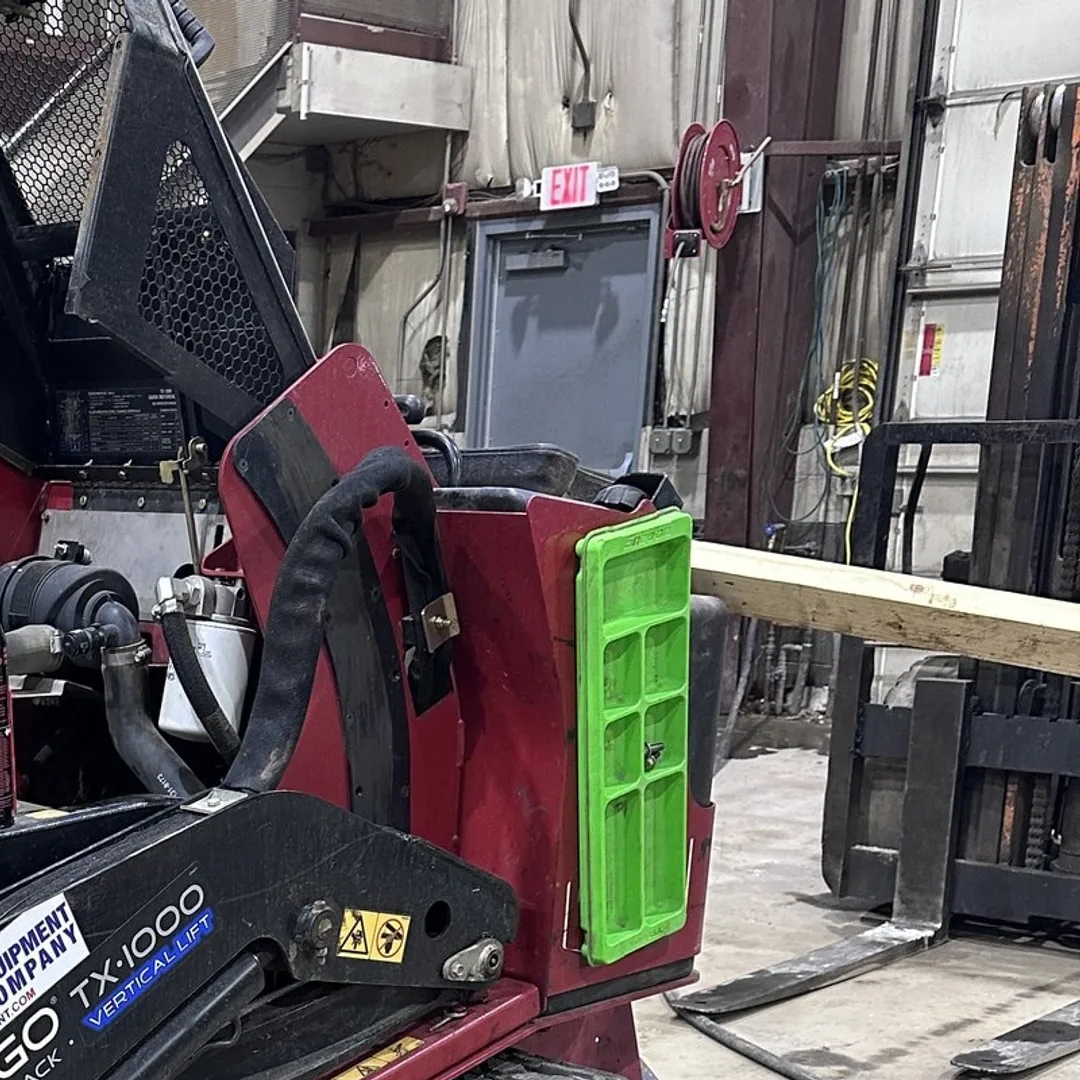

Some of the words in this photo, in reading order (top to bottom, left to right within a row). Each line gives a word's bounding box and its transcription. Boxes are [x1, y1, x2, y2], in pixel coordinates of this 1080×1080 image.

[550, 165, 589, 205] EXIT
[89, 951, 176, 1026] VERTICAL
[176, 914, 210, 952] LIFT
